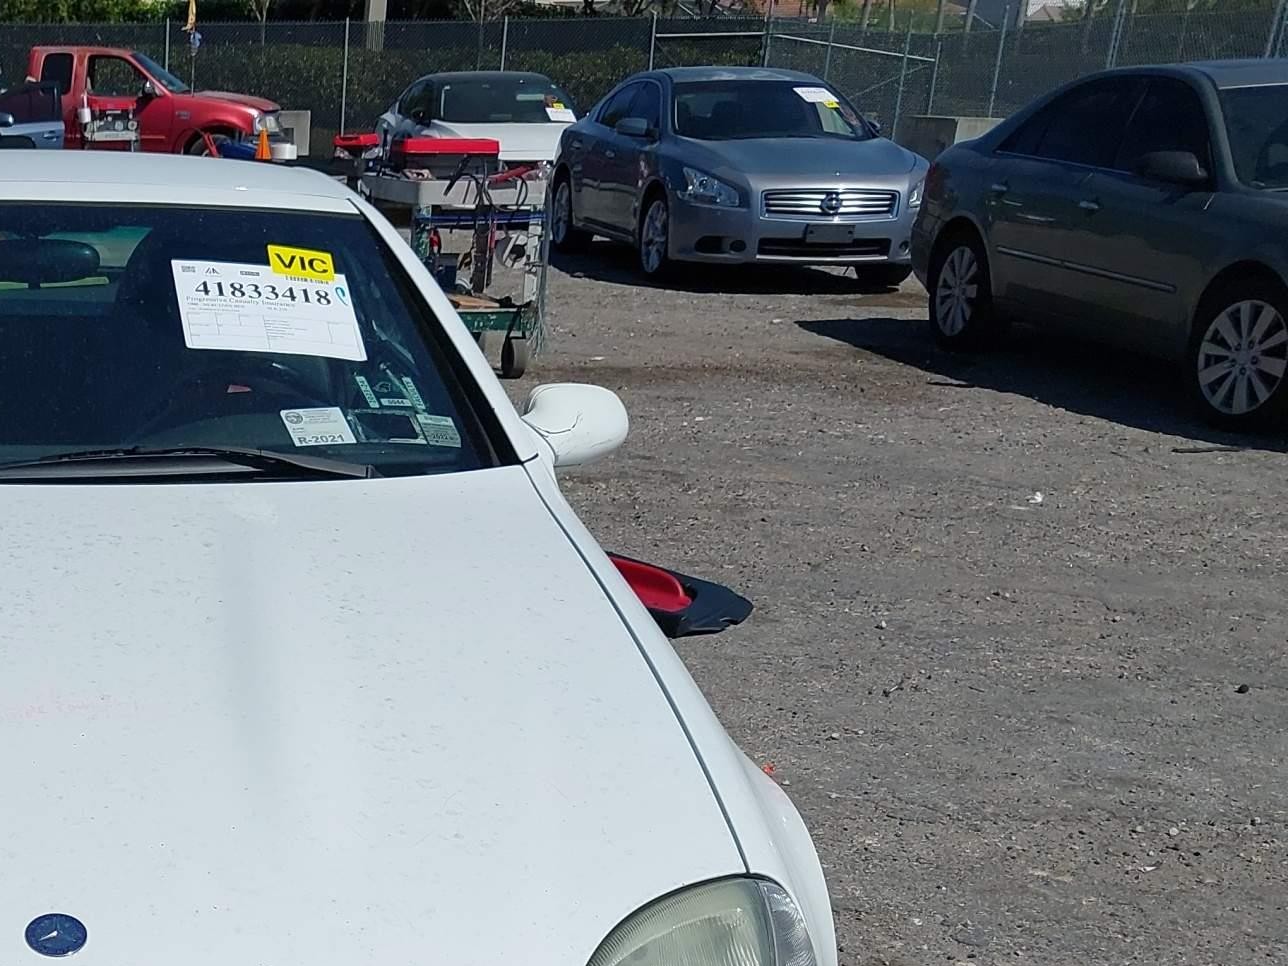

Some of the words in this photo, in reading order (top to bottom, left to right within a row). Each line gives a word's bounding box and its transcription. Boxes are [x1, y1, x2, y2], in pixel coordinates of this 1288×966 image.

[274, 252, 329, 274] VIC
[194, 280, 332, 306] 41833418
[297, 434, 345, 445] R-2021
